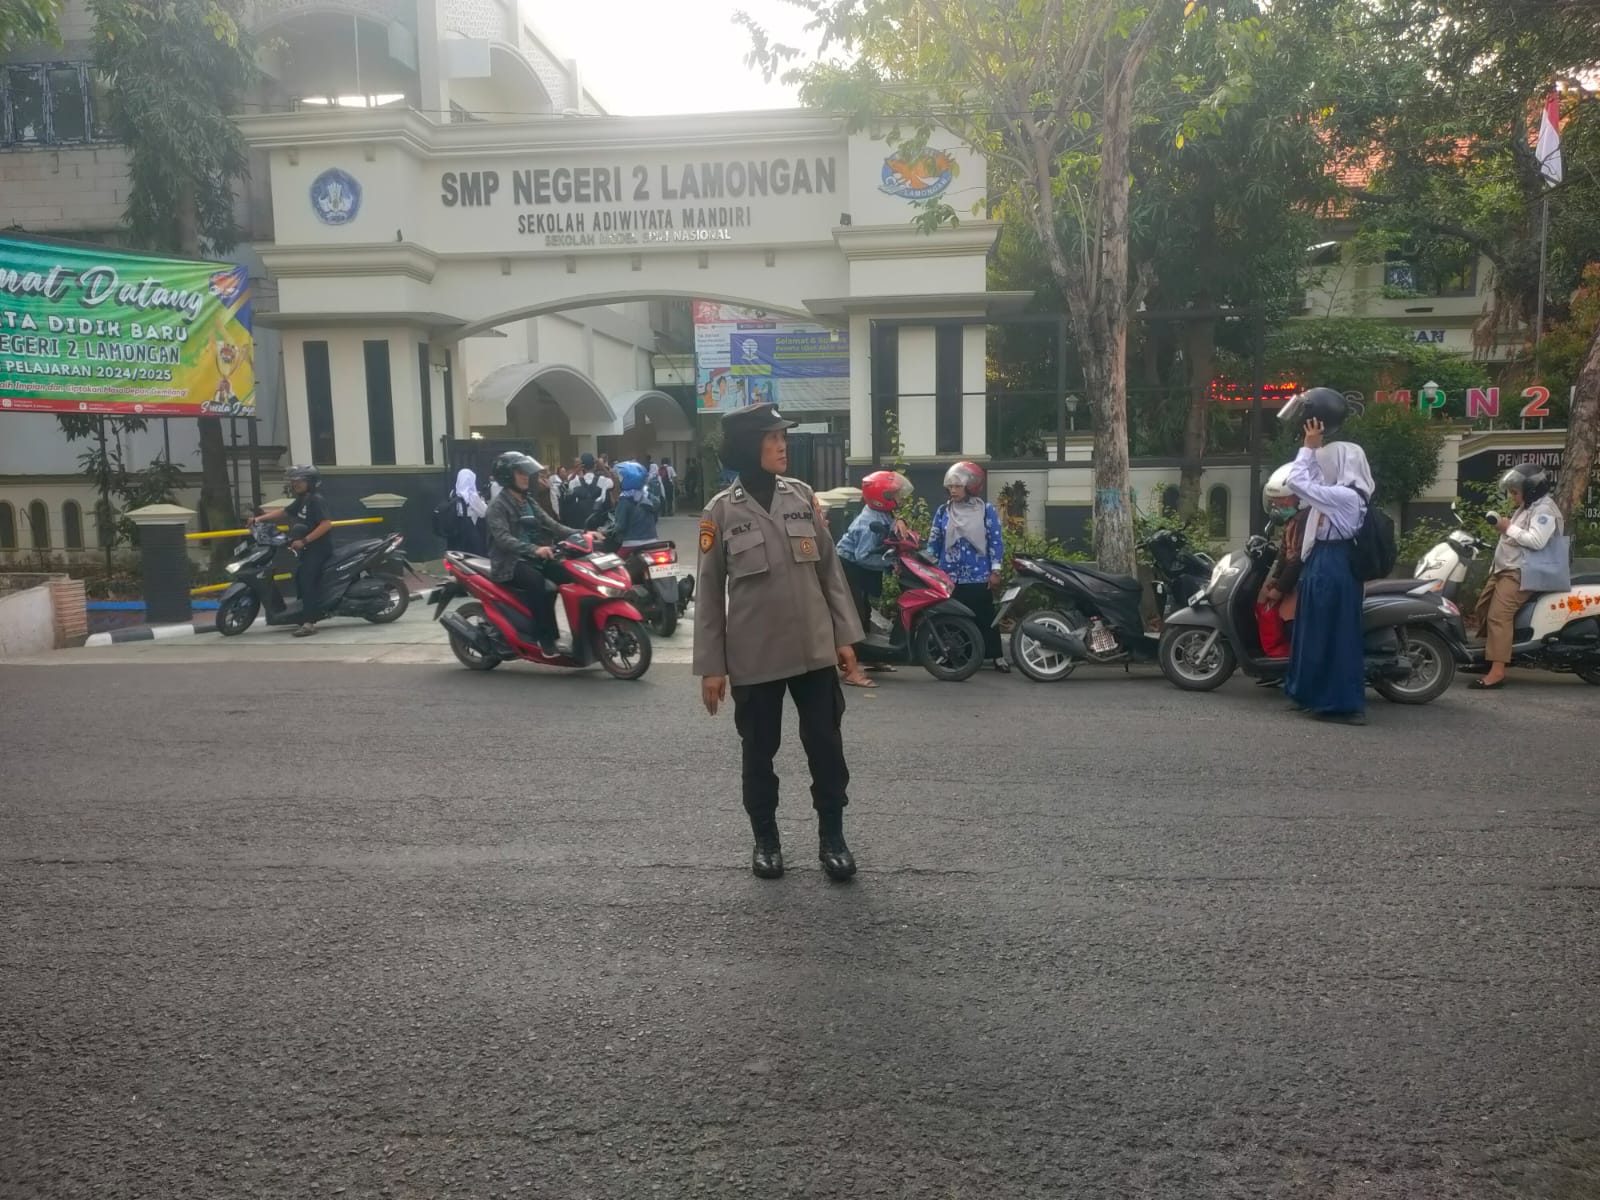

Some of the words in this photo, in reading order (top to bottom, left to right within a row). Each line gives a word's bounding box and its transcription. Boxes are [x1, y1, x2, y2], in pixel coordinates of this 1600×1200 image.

[441, 170, 499, 207] SMP
[513, 166, 622, 205] NEGERI
[632, 165, 650, 201] 2
[661, 156, 836, 201] LAMONGAN
[517, 212, 585, 235] SEKOLAH
[592, 208, 674, 232] ADIWIYATA
[682, 206, 752, 229] MANDIRI
[544, 233, 596, 247] SEKOLAH
[673, 228, 732, 242] NASIONAL
[80, 265, 205, 321] Datang
[0, 311, 38, 331] TA
[48, 315, 121, 338] DIDIK
[131, 322, 188, 342] BARU
[0, 334, 60, 358] EGERI
[67, 340, 80, 359] 2
[86, 341, 181, 366] LAMONGAN
[6, 360, 92, 378] PELAJARAN
[96, 366, 172, 382] 2024/2025
[16, 380, 46, 392] Impian
[47, 384, 63, 393] dan
[65, 384, 102, 395] Ciptakan
[1520, 385, 1550, 418] 2
[1497, 452, 1565, 467] PEMERINTA
[783, 511, 812, 521] POLRI
[731, 522, 753, 536] ELY
